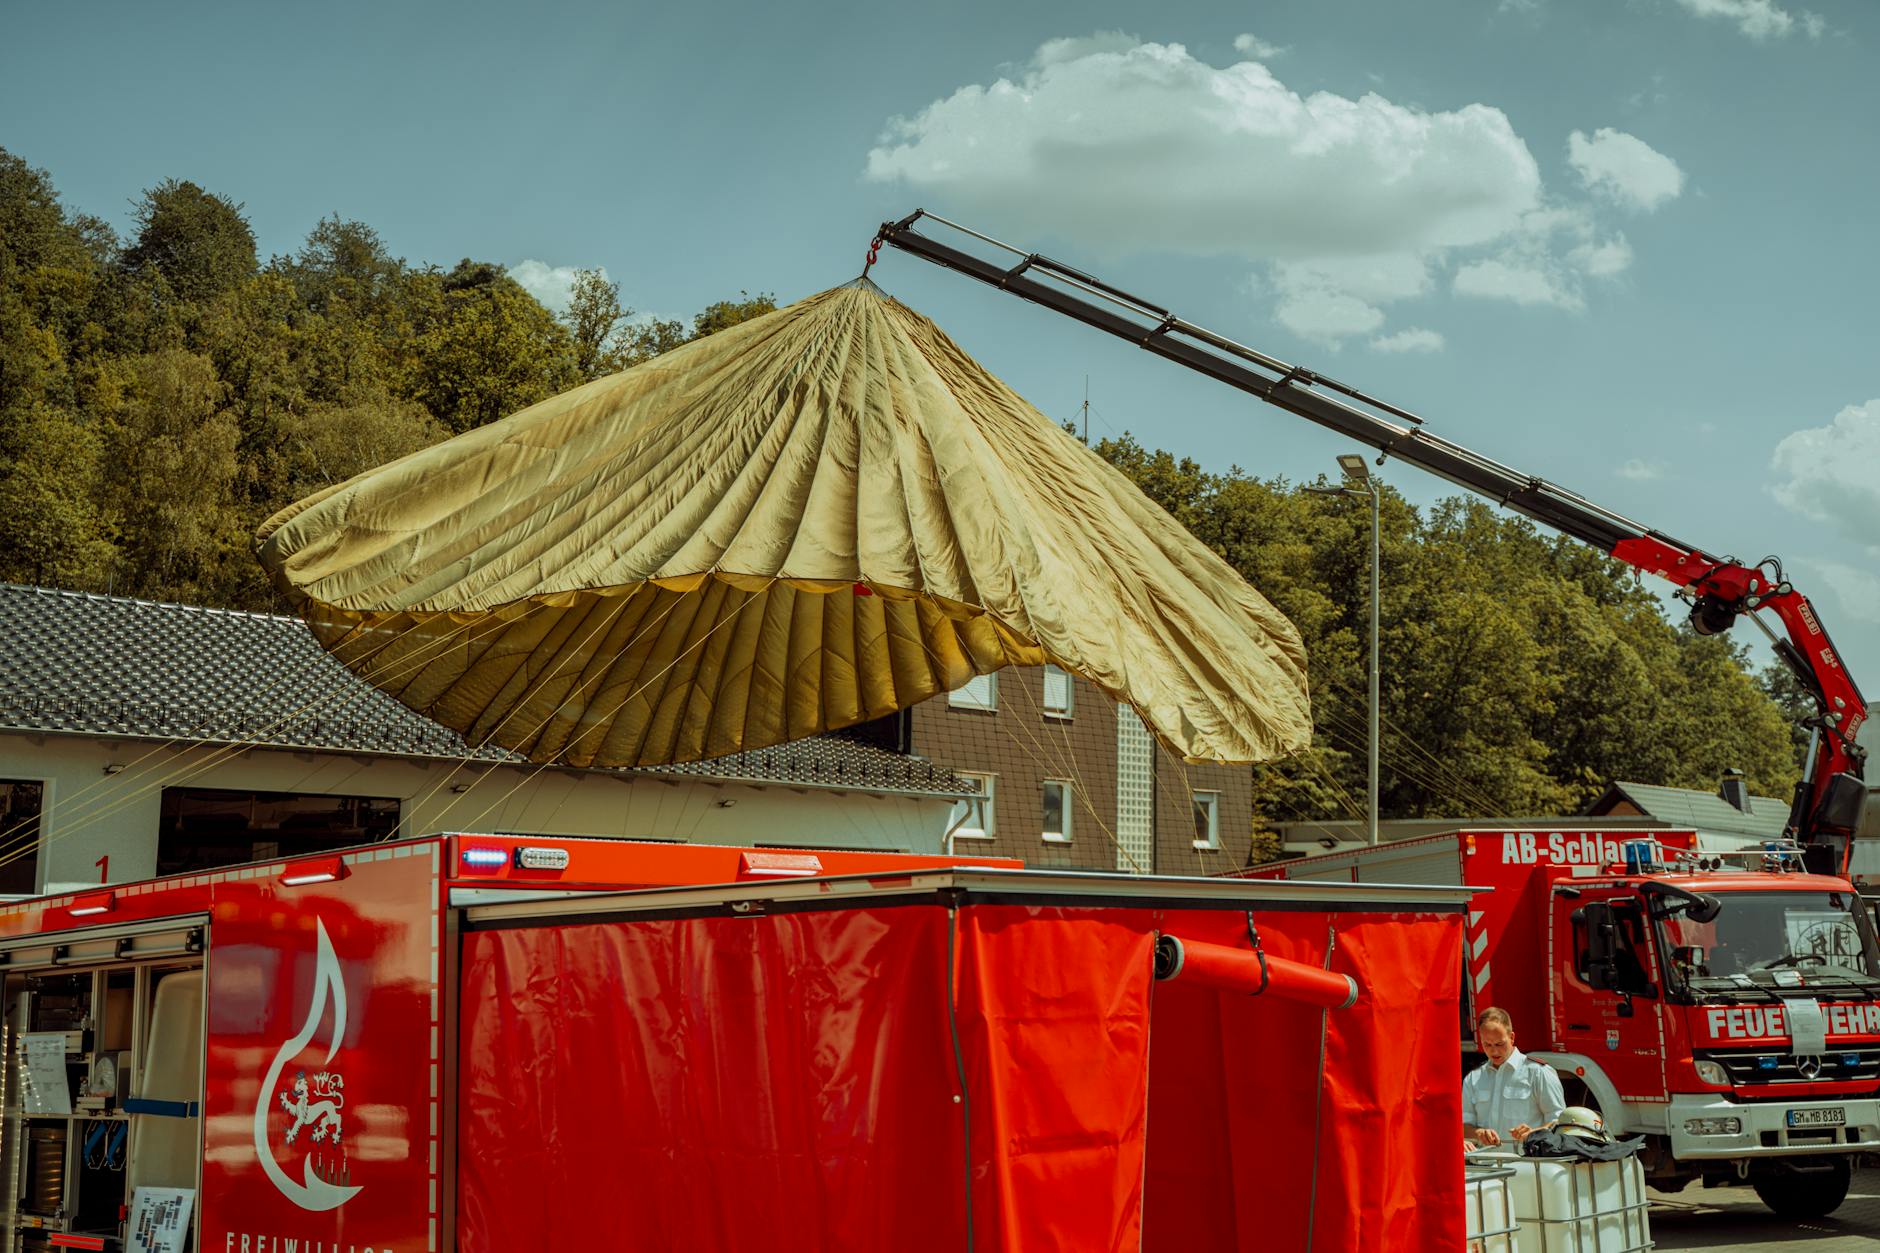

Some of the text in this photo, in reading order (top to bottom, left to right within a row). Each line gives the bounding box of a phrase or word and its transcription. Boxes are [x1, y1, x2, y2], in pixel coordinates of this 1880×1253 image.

[1502, 832, 1664, 865] AB-Schlah
[95, 855, 109, 884] 1
[1707, 1005, 1880, 1039] FEUEEHR
[1822, 1109, 1844, 1122] 8181
